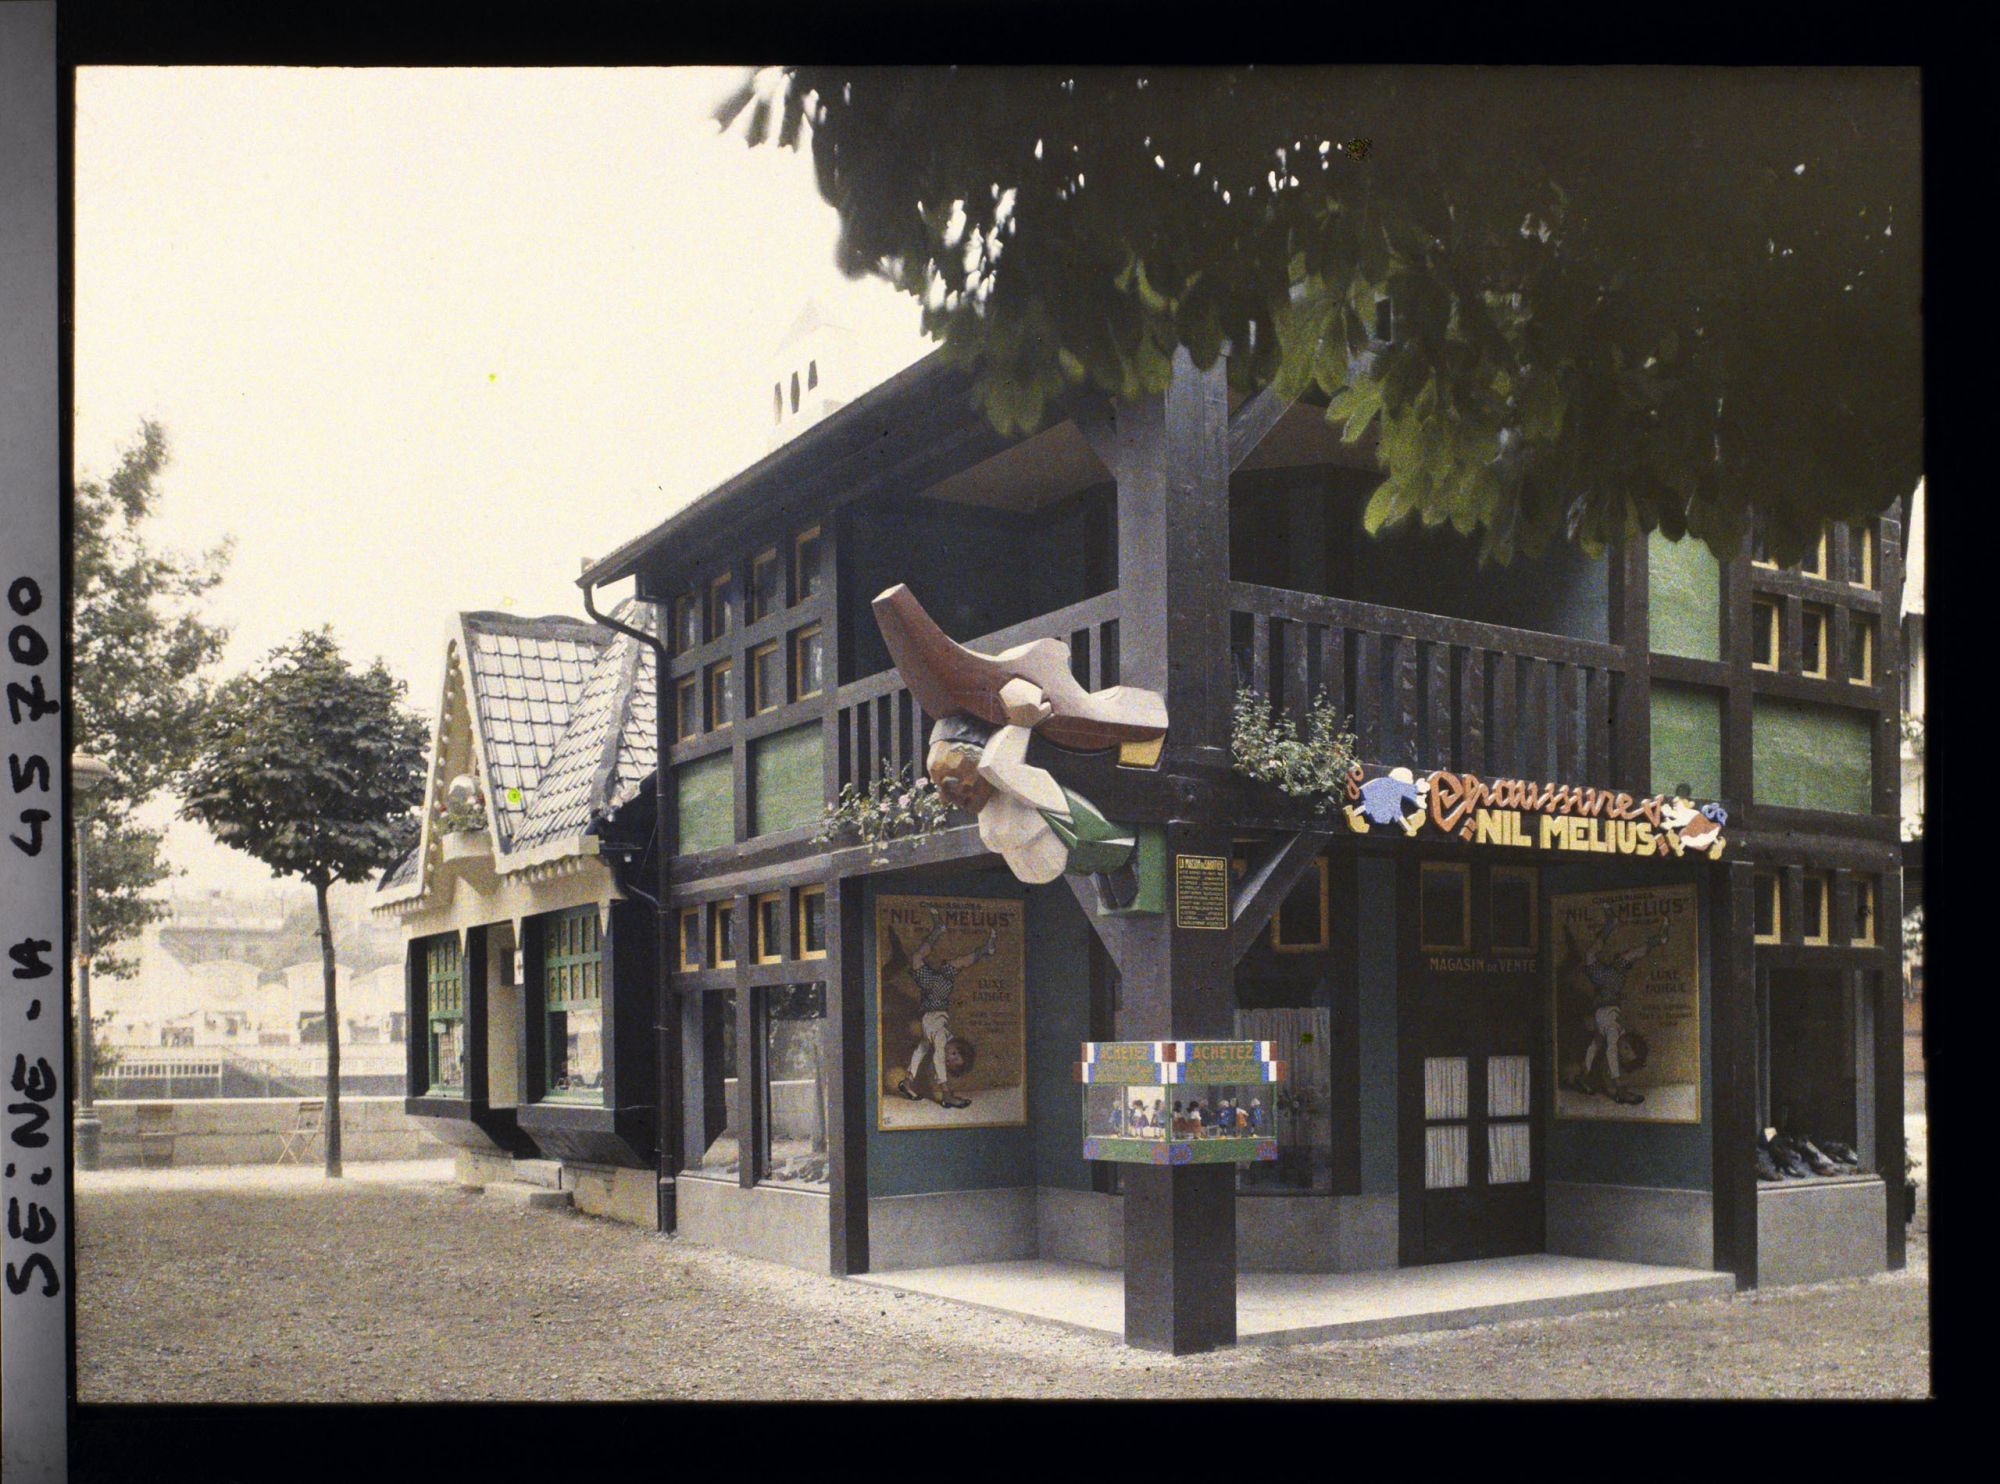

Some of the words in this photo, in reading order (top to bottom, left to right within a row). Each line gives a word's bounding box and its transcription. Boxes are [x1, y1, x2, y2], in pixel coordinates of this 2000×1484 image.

[1475, 808, 1532, 847] NIL
[1539, 813, 1658, 857] MELIUS
[1429, 957, 1485, 973] MAGASIN
[1499, 959, 1537, 973] VENTE
[1191, 1044, 1254, 1060] ACHETEZ
